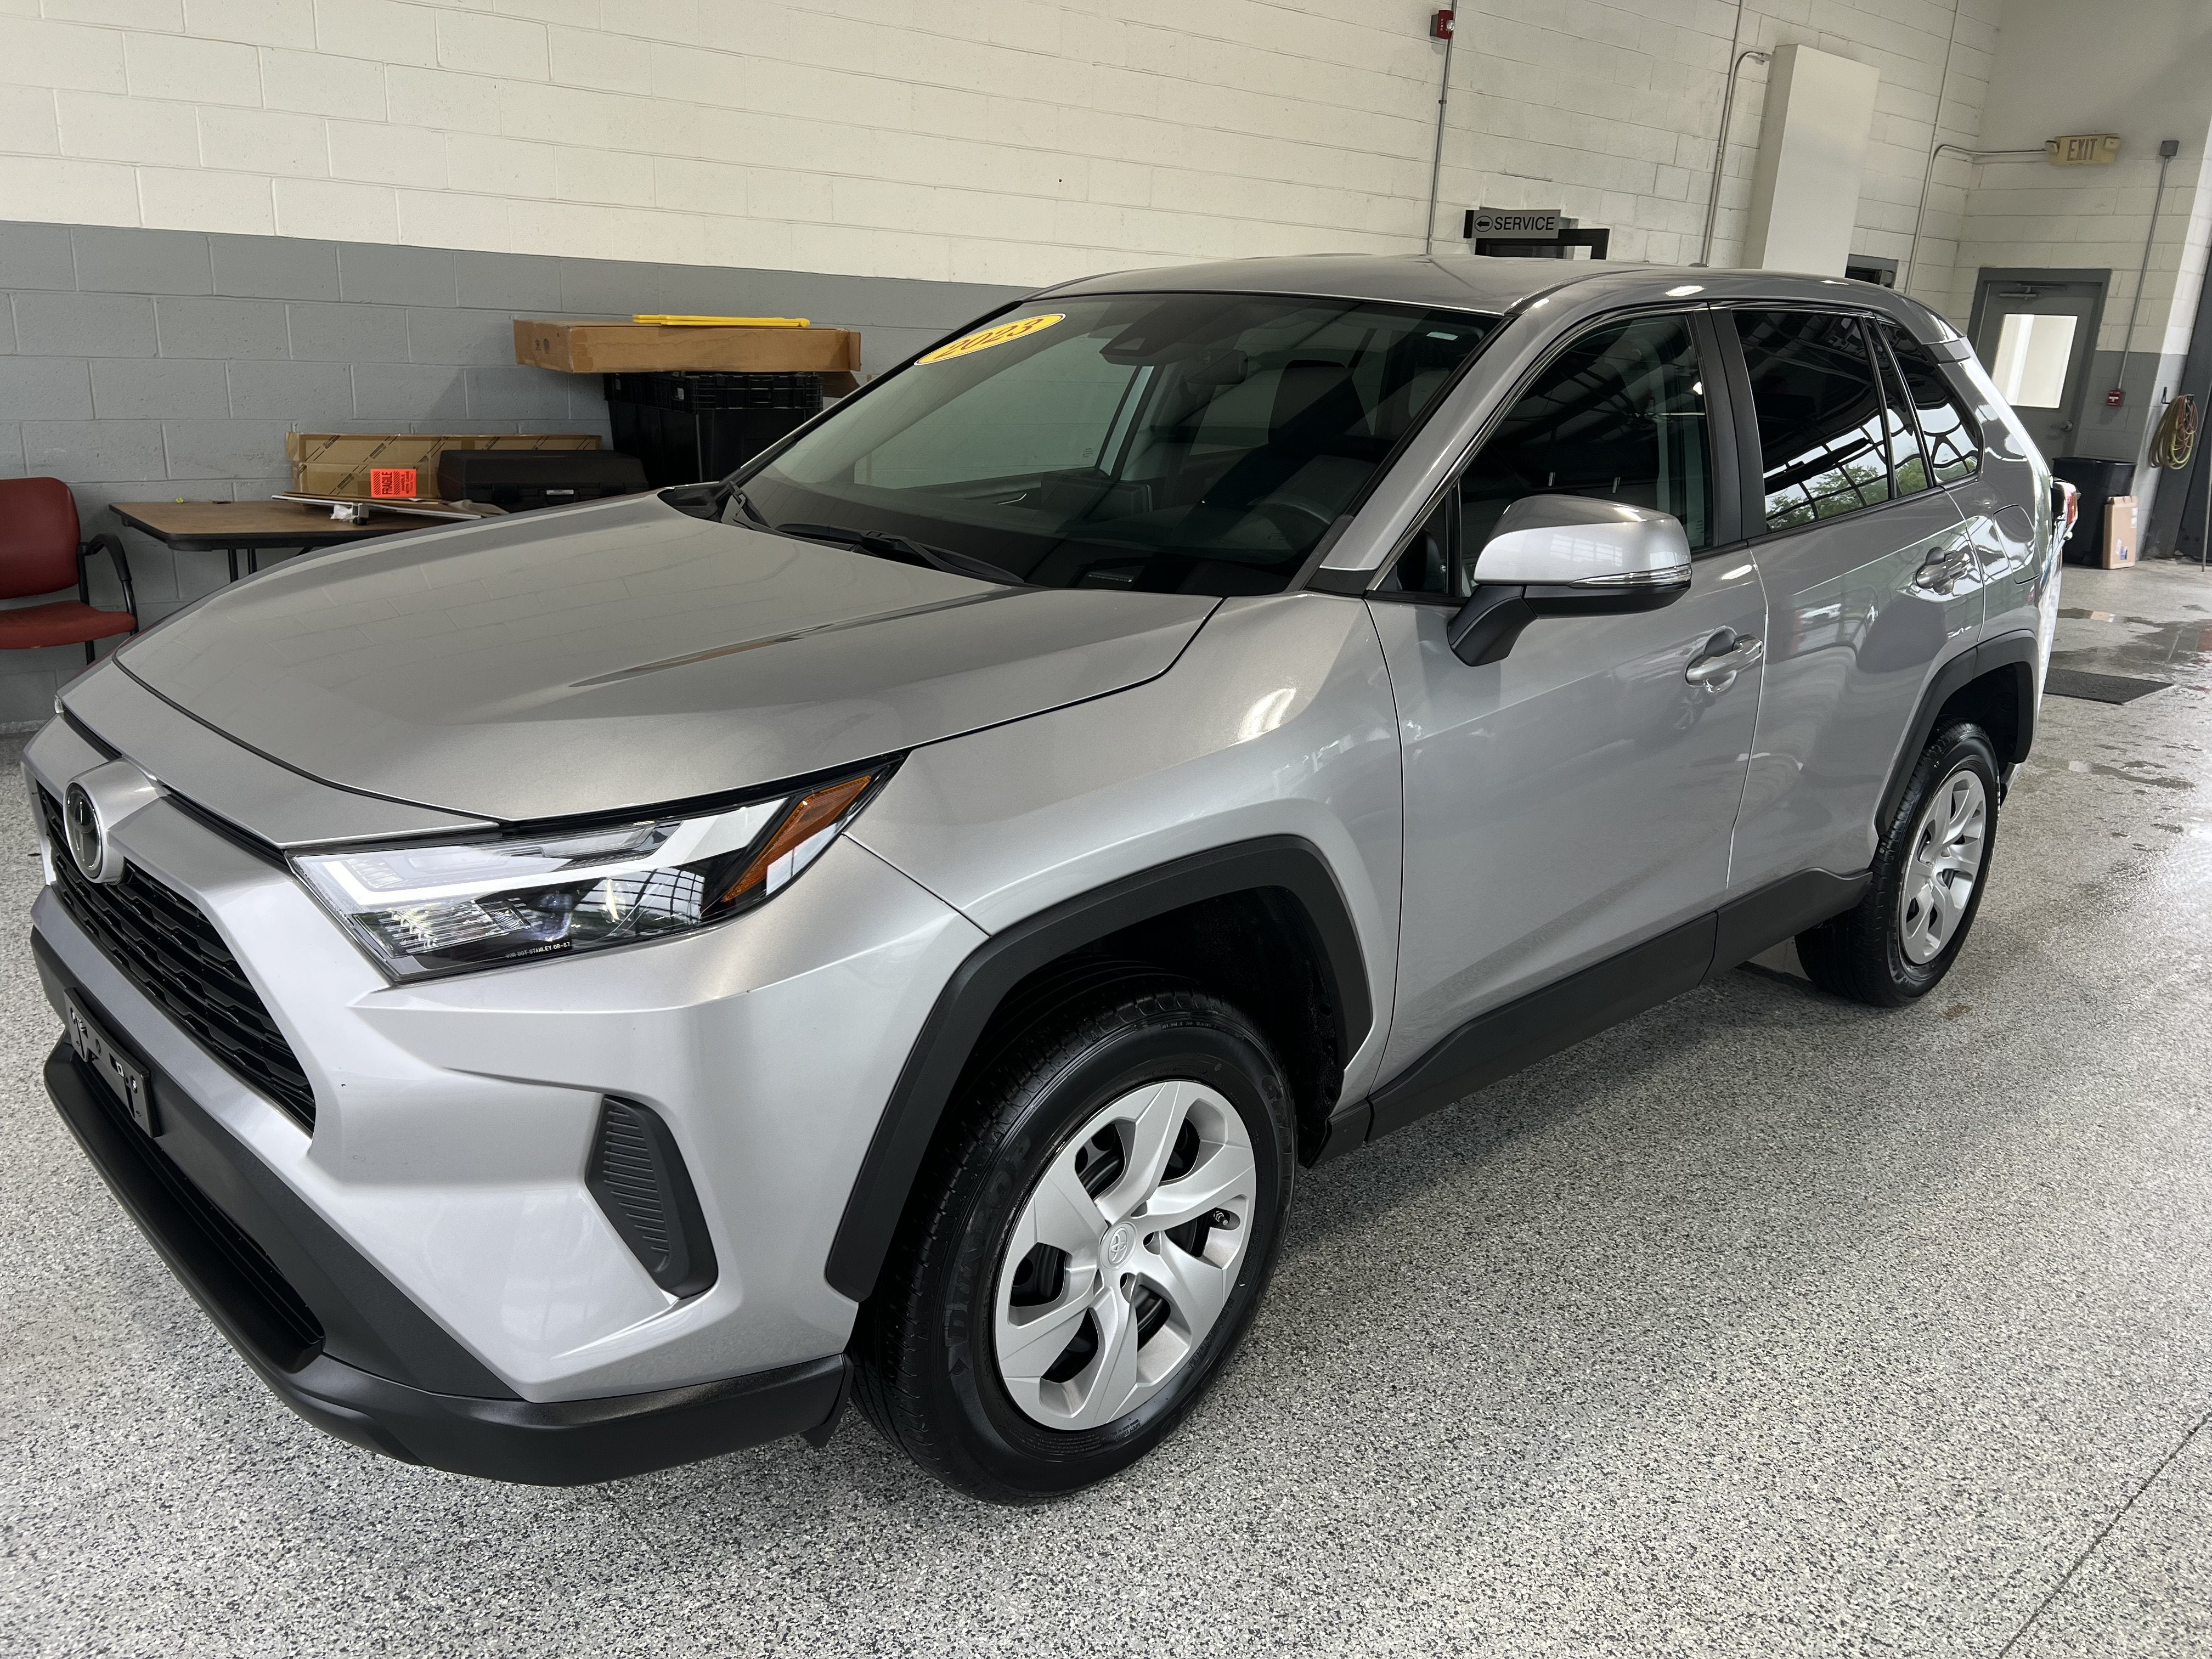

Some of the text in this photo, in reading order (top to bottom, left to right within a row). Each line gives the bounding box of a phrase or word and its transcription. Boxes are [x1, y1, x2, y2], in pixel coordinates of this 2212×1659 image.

[2067, 138, 2098, 161] EXIT
[1494, 216, 1555, 231] SERVICE
[934, 318, 1044, 360] 2023
[381, 472, 393, 494] FRAGILE
[529, 945, 552, 955] STANLEY
